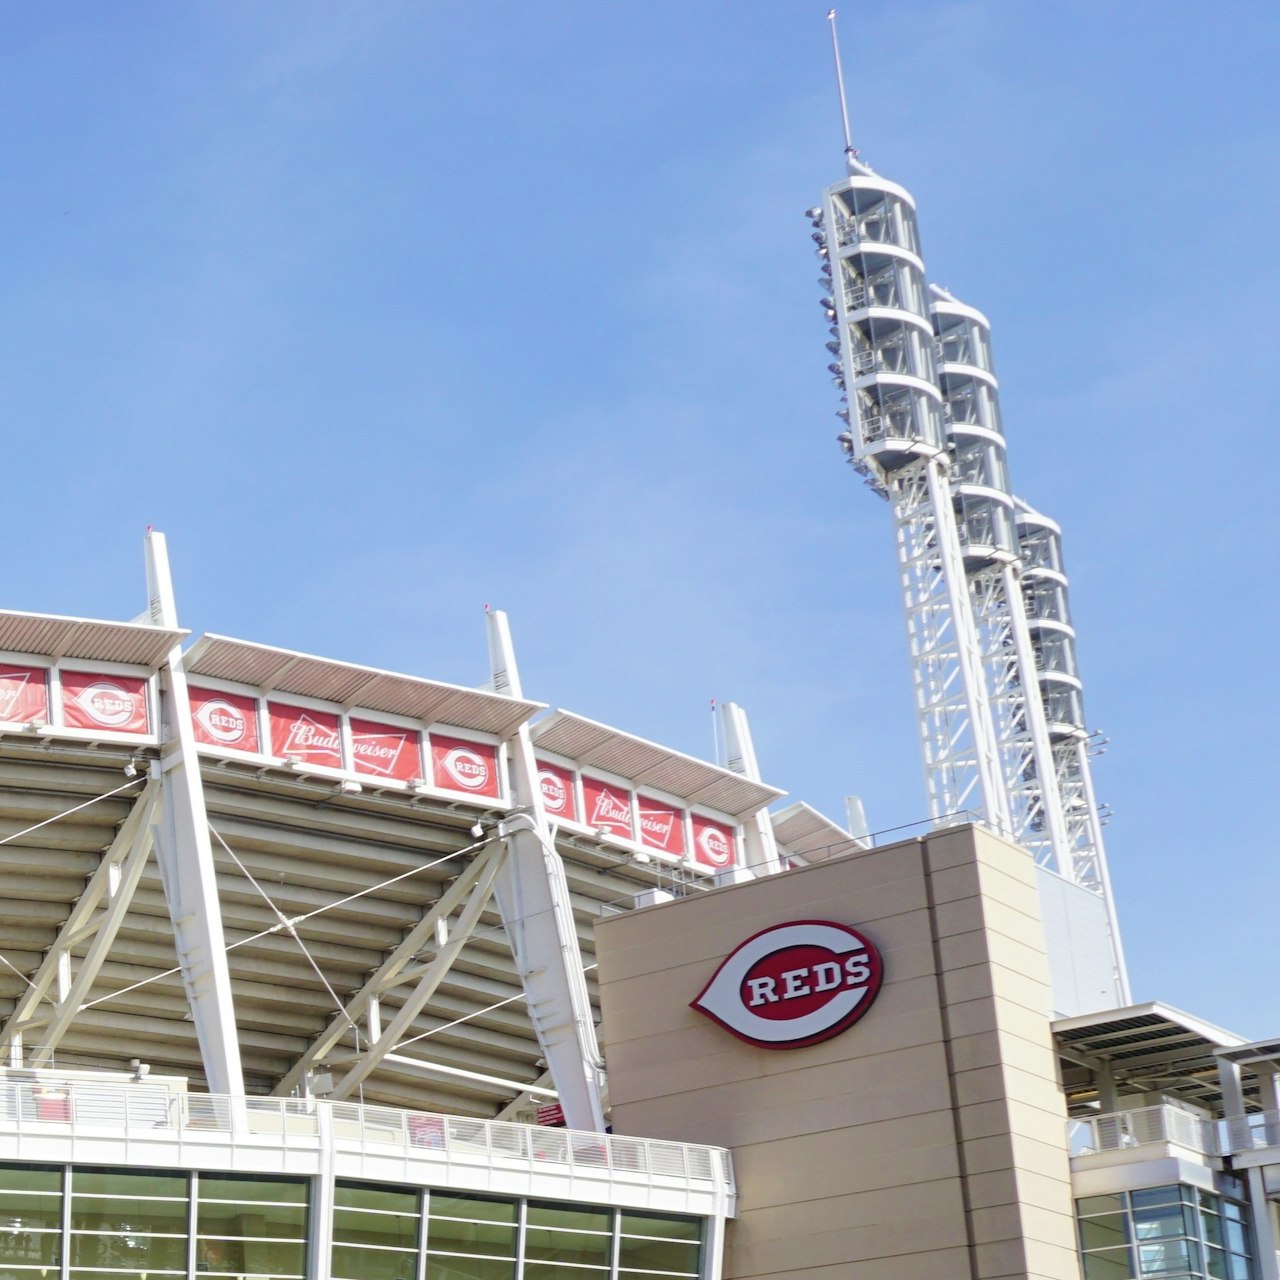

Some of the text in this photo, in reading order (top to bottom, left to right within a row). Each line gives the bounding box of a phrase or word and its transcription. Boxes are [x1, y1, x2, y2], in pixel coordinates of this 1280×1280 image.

[93, 698, 133, 714] REDS
[210, 714, 244, 731] REDS
[455, 761, 487, 777] REDS
[747, 953, 872, 1007] REDS
